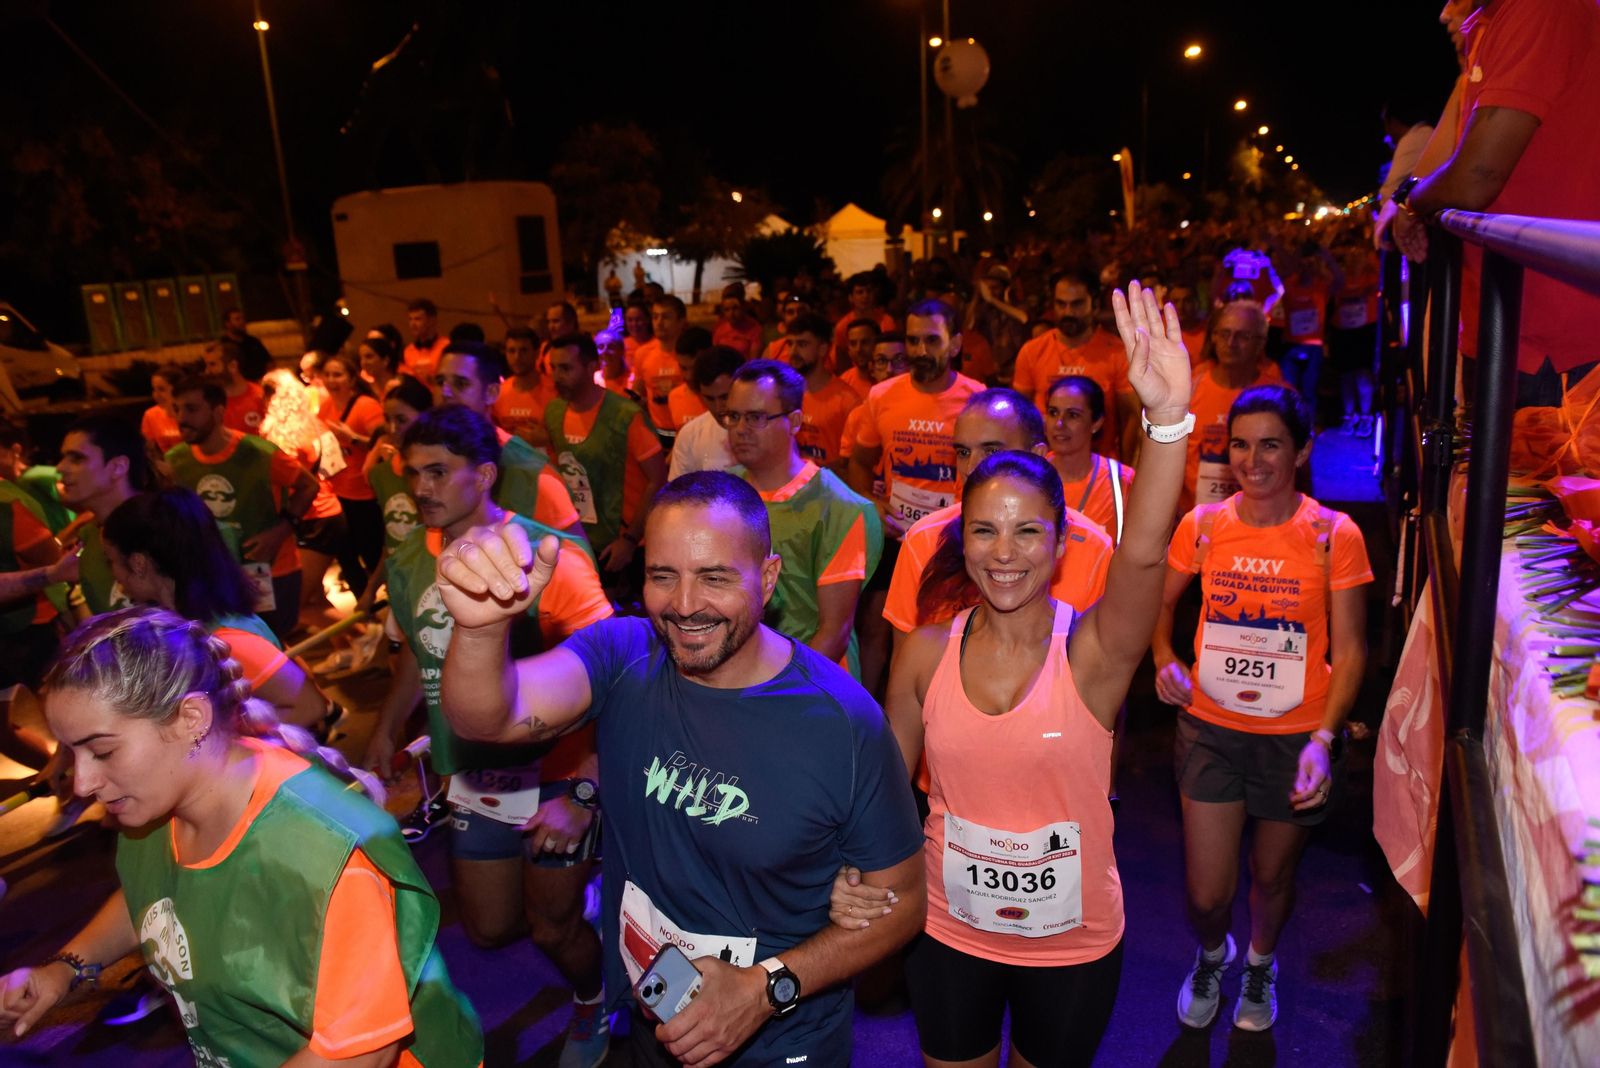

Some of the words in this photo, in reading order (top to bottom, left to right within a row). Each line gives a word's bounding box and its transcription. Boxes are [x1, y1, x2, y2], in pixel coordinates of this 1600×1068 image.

[908, 418, 945, 433] XXXV
[1231, 555, 1285, 576] XXXV
[1211, 570, 1248, 581] CARRERA
[1252, 575, 1300, 586] NOCTURNA
[1211, 593, 1231, 604] KH7
[1225, 656, 1276, 680] 9251
[645, 755, 750, 827] WILD
[966, 864, 1056, 894] 13036
[967, 888, 990, 898] RAQUEL
[991, 894, 1027, 903] RODRIGUEZ
[1029, 893, 1057, 903] SANCHEZ
[1000, 909, 1023, 918] KH7
[1042, 917, 1077, 930] Cruzcampo
[144, 906, 157, 933] TUS
[175, 933, 189, 973] SON
